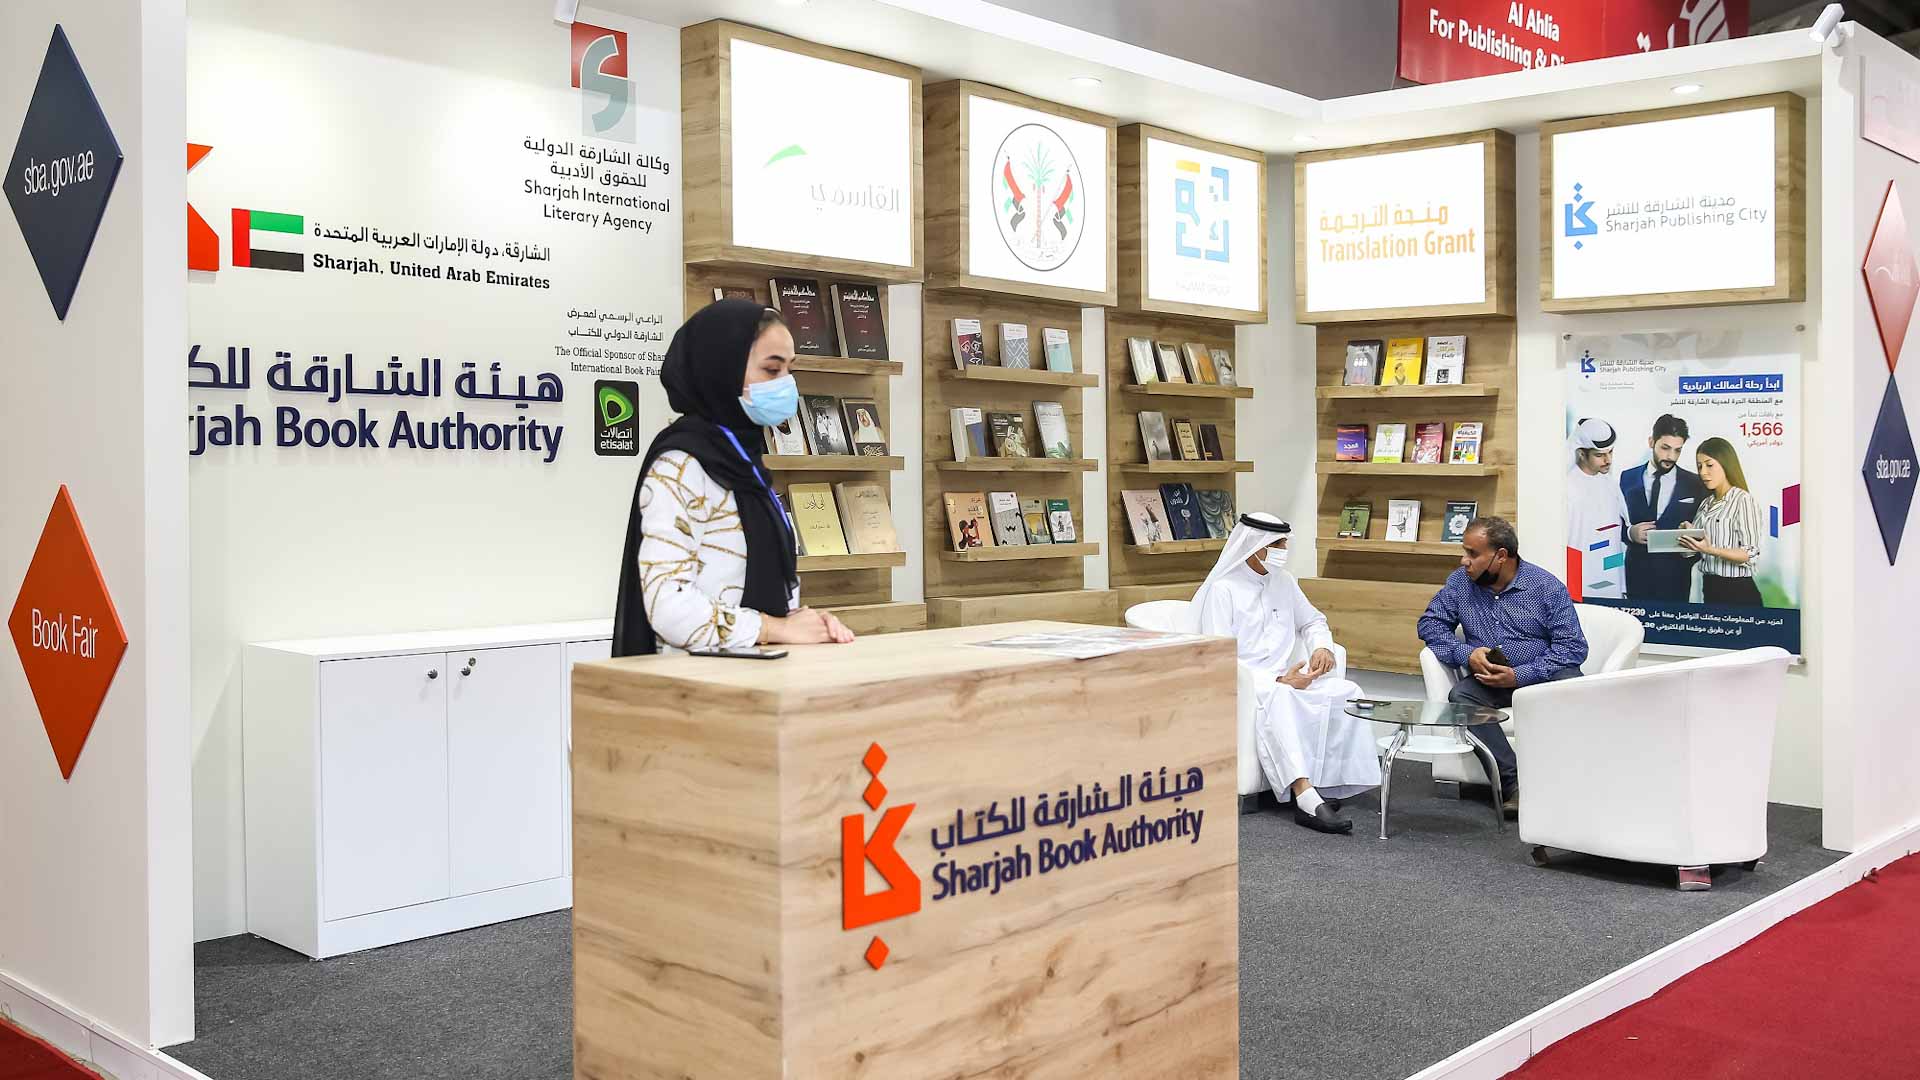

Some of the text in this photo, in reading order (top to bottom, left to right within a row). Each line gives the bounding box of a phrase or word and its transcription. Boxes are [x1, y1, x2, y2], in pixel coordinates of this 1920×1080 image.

[1507, 1, 1560, 42] Al Ahlia
[1429, 8, 1455, 40] For
[1458, 18, 1532, 71] Publishing
[523, 135, 670, 175] وكالة الشارقة الدولية
[24, 149, 94, 197] sba.gov.ae
[550, 160, 647, 188] للحقوق الأدبية
[524, 179, 670, 213] Sharjah International
[313, 222, 369, 243] المتحدة
[543, 203, 652, 234] Literary Agency
[1606, 207, 1768, 233] Sharjah Publishing City
[372, 227, 420, 250] العربية
[423, 234, 468, 256] الإمارات
[470, 239, 499, 259] دولة
[1320, 228, 1476, 263] Translation Grant
[312, 252, 550, 290] Sharjah, United Arab Emirates
[555, 345, 666, 362] The Official Sponsor of Shar
[570, 362, 623, 375] International
[624, 364, 644, 375] Book
[188, 344, 565, 409] هيئة الشارقة للك
[1682, 377, 1780, 393] ابدأ رحلة أعمالك الريادية
[188, 404, 564, 463] jah Book Authority
[600, 428, 633, 439] اتصالات
[600, 439, 634, 450] etisalat
[1739, 422, 1784, 437] 1,566
[31, 608, 99, 660] Book Fair
[931, 766, 1204, 858] هيئة الشارقة للكتاب
[932, 808, 1204, 901] Sharjah Book Authority
